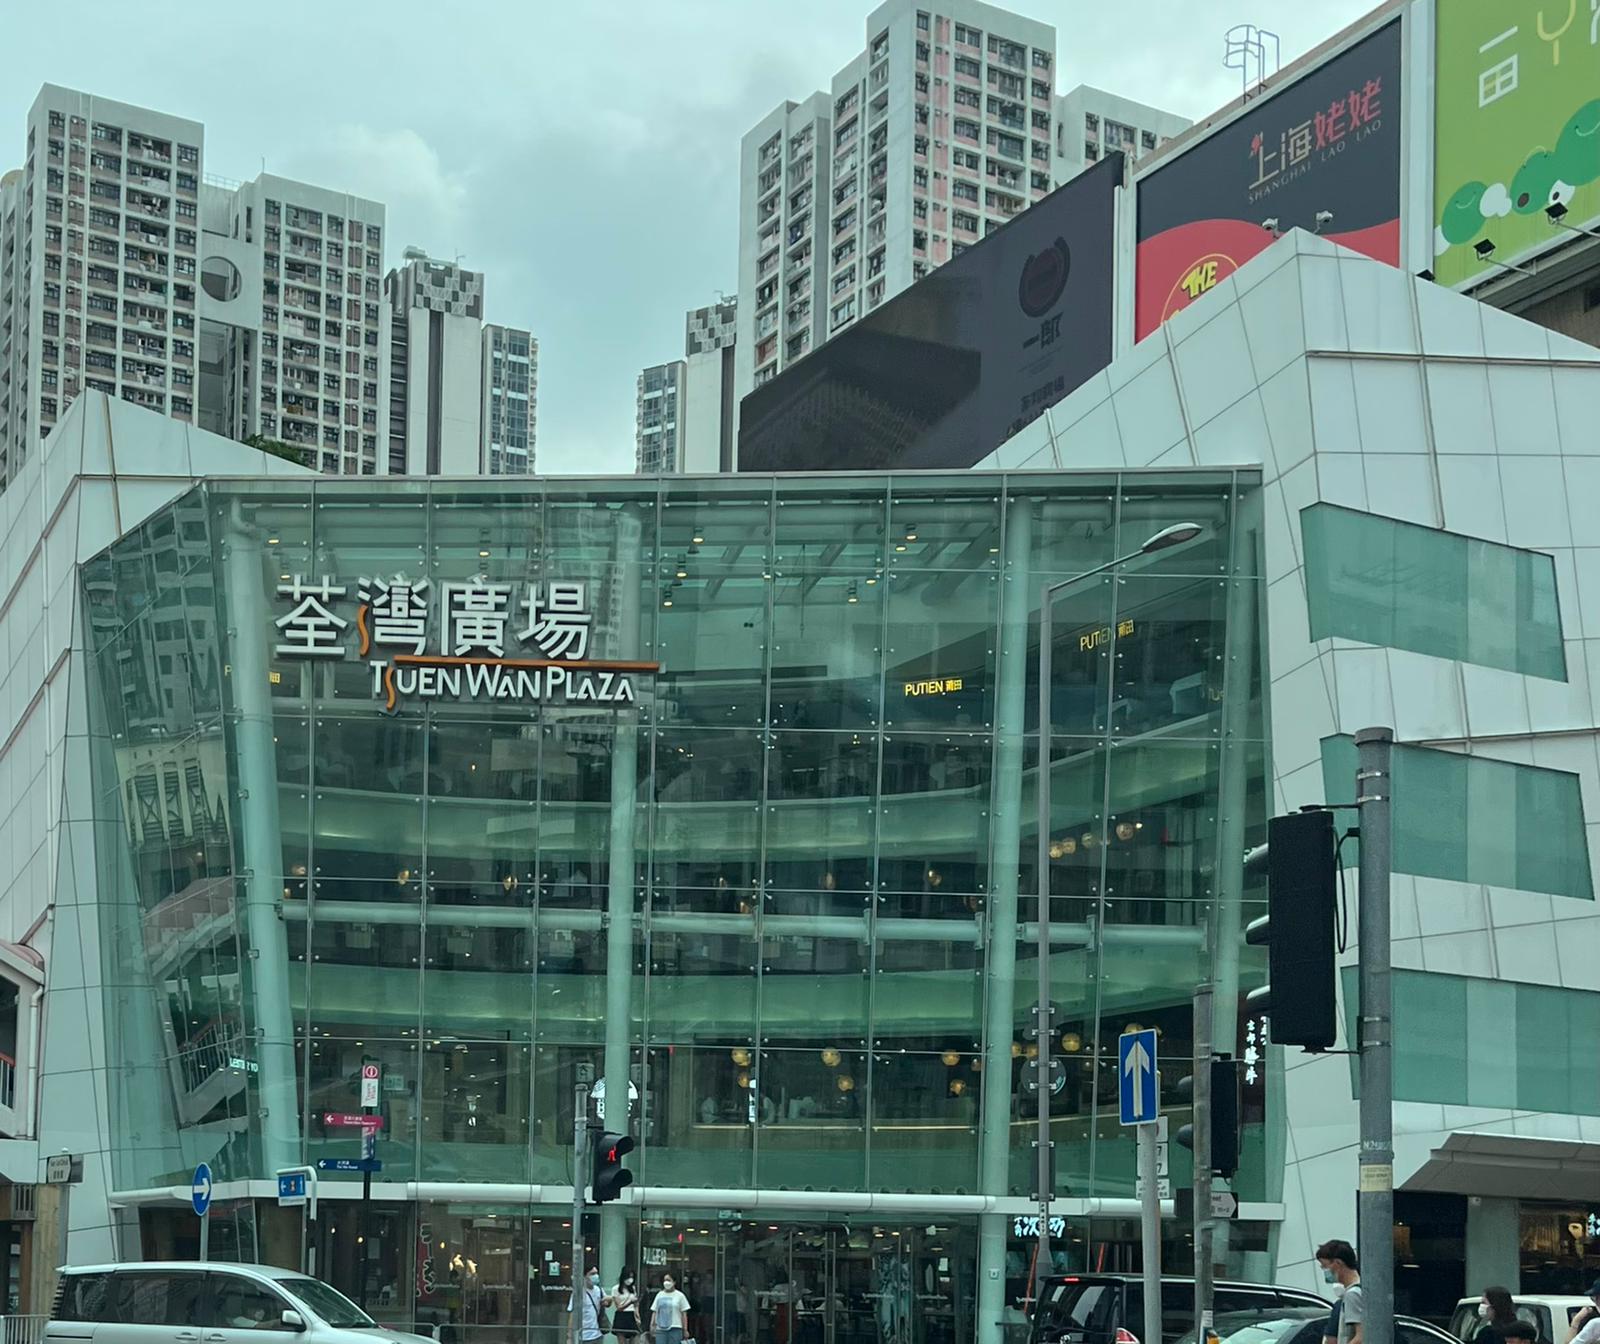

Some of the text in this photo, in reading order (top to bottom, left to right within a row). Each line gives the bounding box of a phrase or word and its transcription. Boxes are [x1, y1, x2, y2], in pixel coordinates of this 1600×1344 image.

[1248, 77, 1383, 189] 上海姥姥
[1248, 119, 1383, 205] SHANGHAI LAO LAO
[1181, 261, 1218, 299] THE
[273, 572, 593, 660] 荃灣廣場
[369, 659, 635, 712] TSUEN WAN PLAZA
[905, 680, 943, 696] PUTIEN
